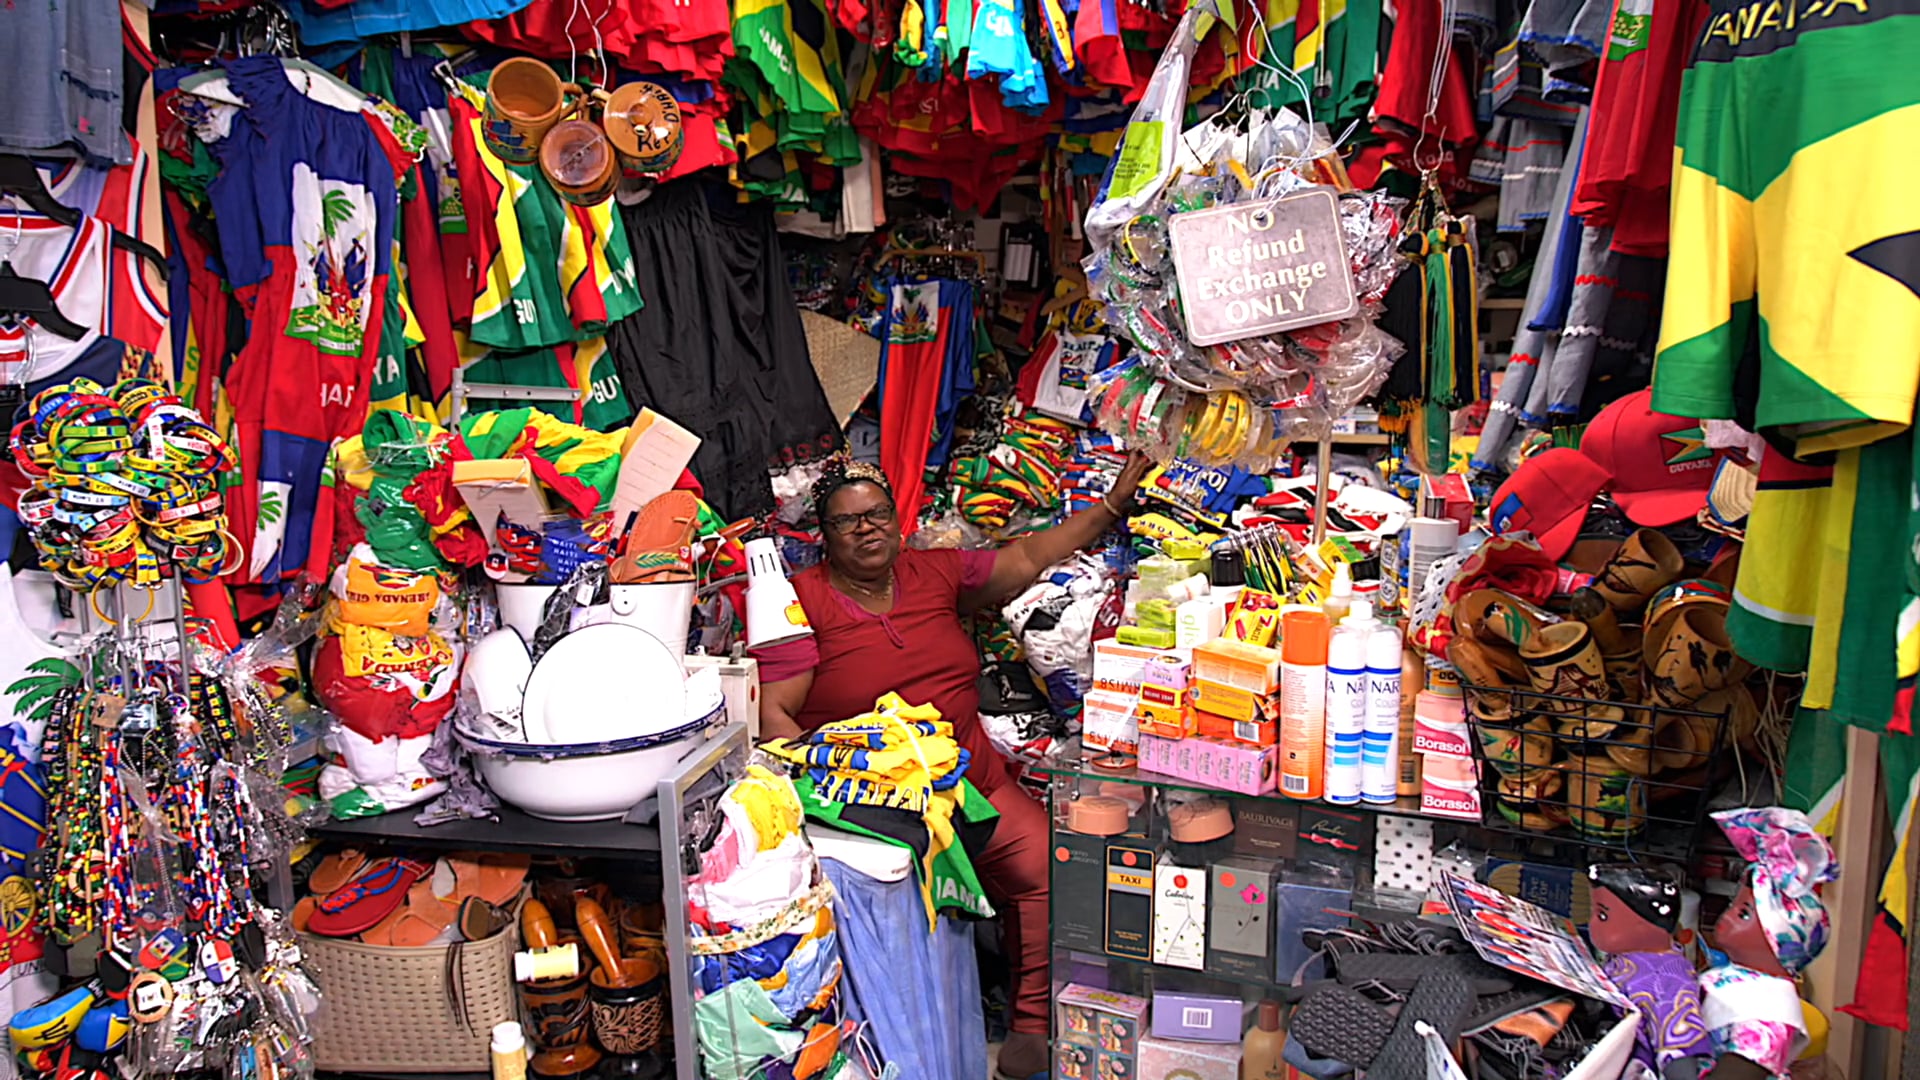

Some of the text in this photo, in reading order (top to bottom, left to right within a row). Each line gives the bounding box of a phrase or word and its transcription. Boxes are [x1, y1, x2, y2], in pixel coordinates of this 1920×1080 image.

[1226, 207, 1275, 238] NO
[1207, 229, 1305, 269] Refund
[1199, 260, 1328, 300] Exchange
[1225, 289, 1308, 324] ONLY
[1669, 459, 1713, 475] GUYANA
[1415, 736, 1466, 754] Borasol
[1423, 795, 1475, 811] Borasol
[1119, 875, 1142, 885] TAXI
